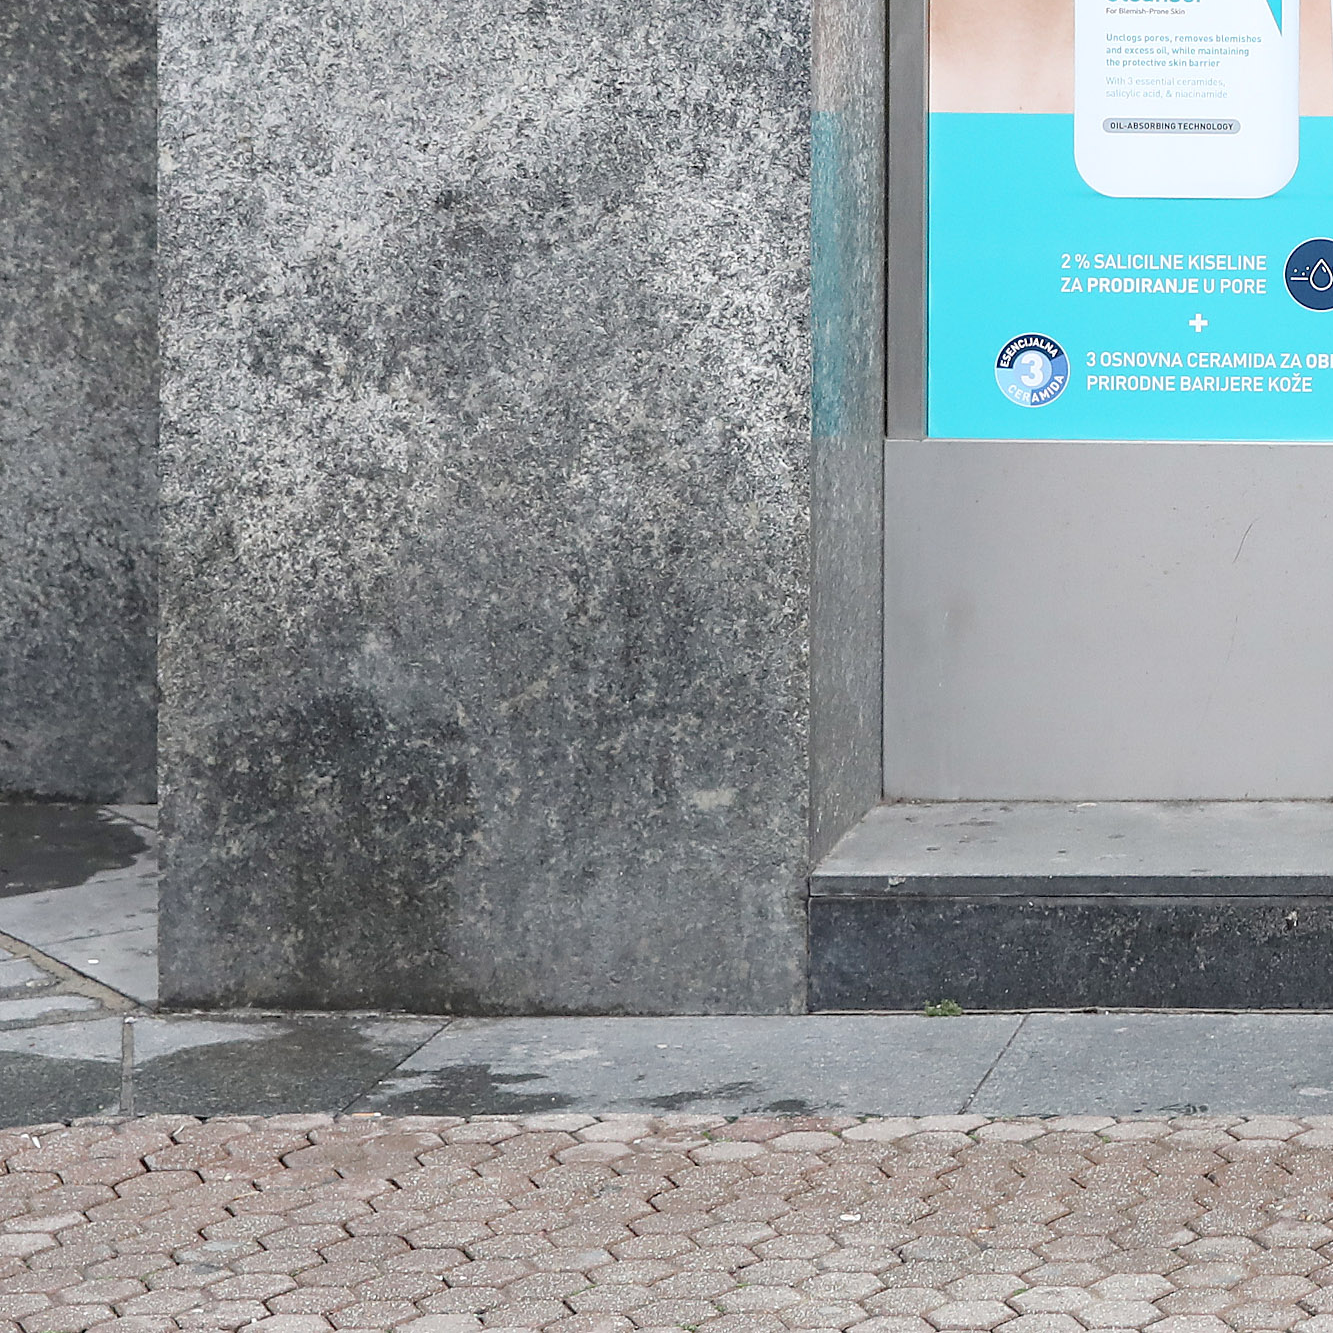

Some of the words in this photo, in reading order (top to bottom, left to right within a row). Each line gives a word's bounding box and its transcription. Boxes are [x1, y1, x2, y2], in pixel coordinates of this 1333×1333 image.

[1106, 34, 1142, 43] Unclogs
[1144, 35, 1173, 44] pores,
[1174, 35, 1214, 43] removes
[1216, 35, 1262, 43] blemishes
[1106, 46, 1122, 54] and
[1172, 47, 1196, 55] while
[1198, 47, 1250, 57] maintaining
[1106, 58, 1120, 66] the
[1122, 59, 1166, 68] protective
[1189, 59, 1220, 67] barrier
[1110, 122, 1176, 130] OIL-ABSORBING
[1178, 122, 1234, 131] TECHNOLOGY
[1060, 254, 1072, 269] 2
[1074, 254, 1090, 269] %
[1094, 254, 1184, 270] SALICILNE
[1188, 254, 1268, 270] KISELINE
[1060, 277, 1084, 293] ZA
[1086, 278, 1199, 294] PRODIRANJE
[1204, 278, 1215, 294] U
[1220, 278, 1267, 294] PORE
[1000, 337, 1059, 368] ESENCIJALNA
[1086, 352, 1096, 367] 3
[1100, 352, 1183, 368] OSNOVNA
[1186, 352, 1276, 368] CERAMIDA
[1280, 353, 1302, 368] ZA
[1021, 353, 1044, 386] 3
[1008, 376, 1065, 403] CERAMIDA
[1086, 375, 1176, 392] PRIRODNE
[1180, 376, 1264, 392] BARIJERE
[1268, 372, 1313, 393] KOŽE
